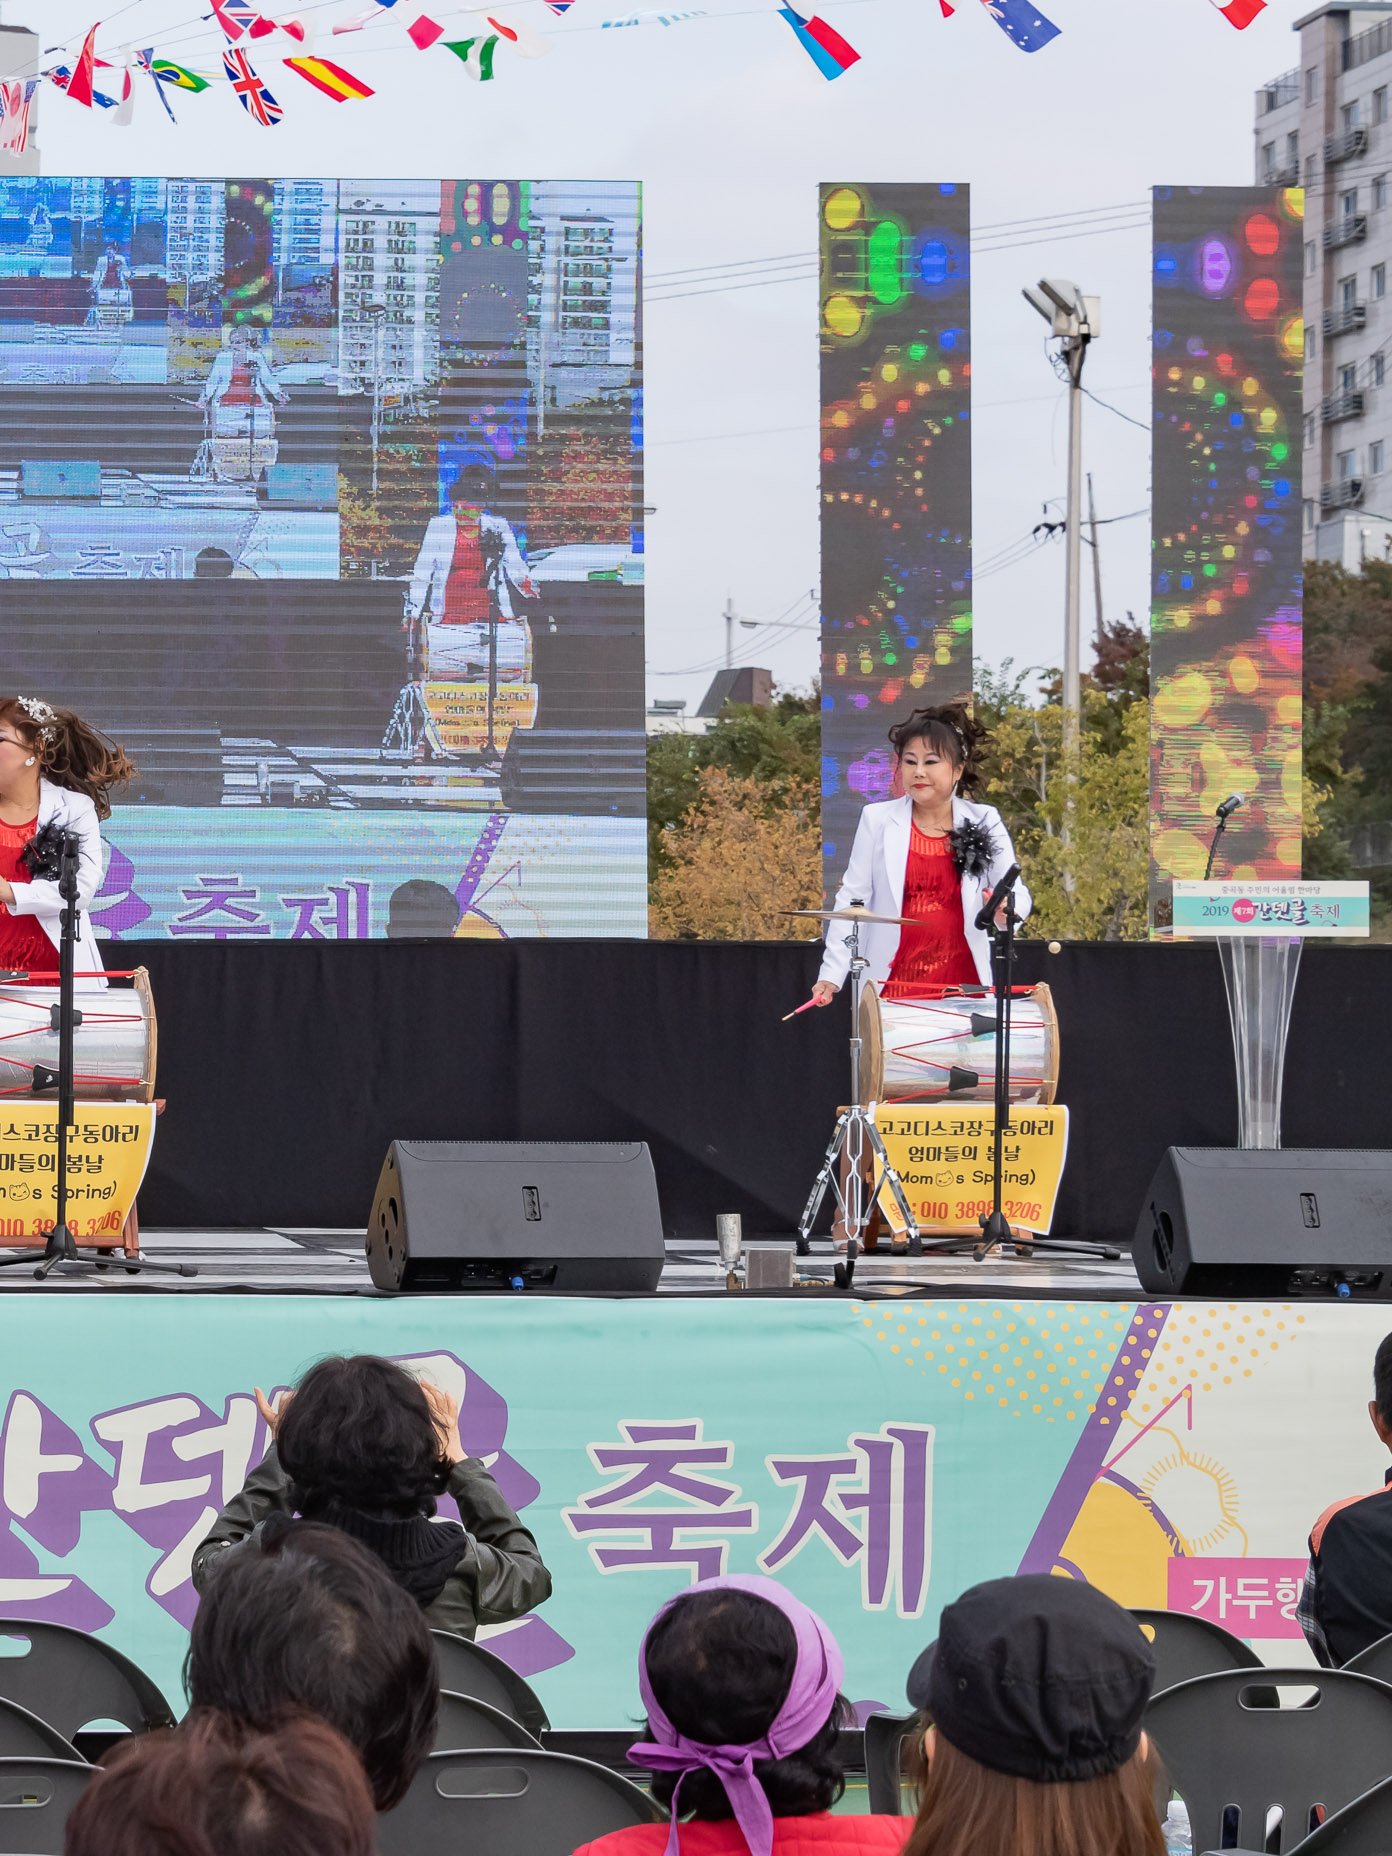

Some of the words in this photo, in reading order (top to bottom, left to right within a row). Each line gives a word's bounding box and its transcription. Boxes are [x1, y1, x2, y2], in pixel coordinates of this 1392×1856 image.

[1202, 905, 1229, 917] 2019
[1233, 906, 1254, 916] 제7회
[1310, 904, 1340, 919] 축제
[65, 1153, 105, 1174] 봄날
[908, 1145, 978, 1163] 엄마들의
[972, 1168, 1036, 1186] Sping)
[1004, 1200, 1042, 1222] 3206
[561, 1417, 936, 1620] 축제
